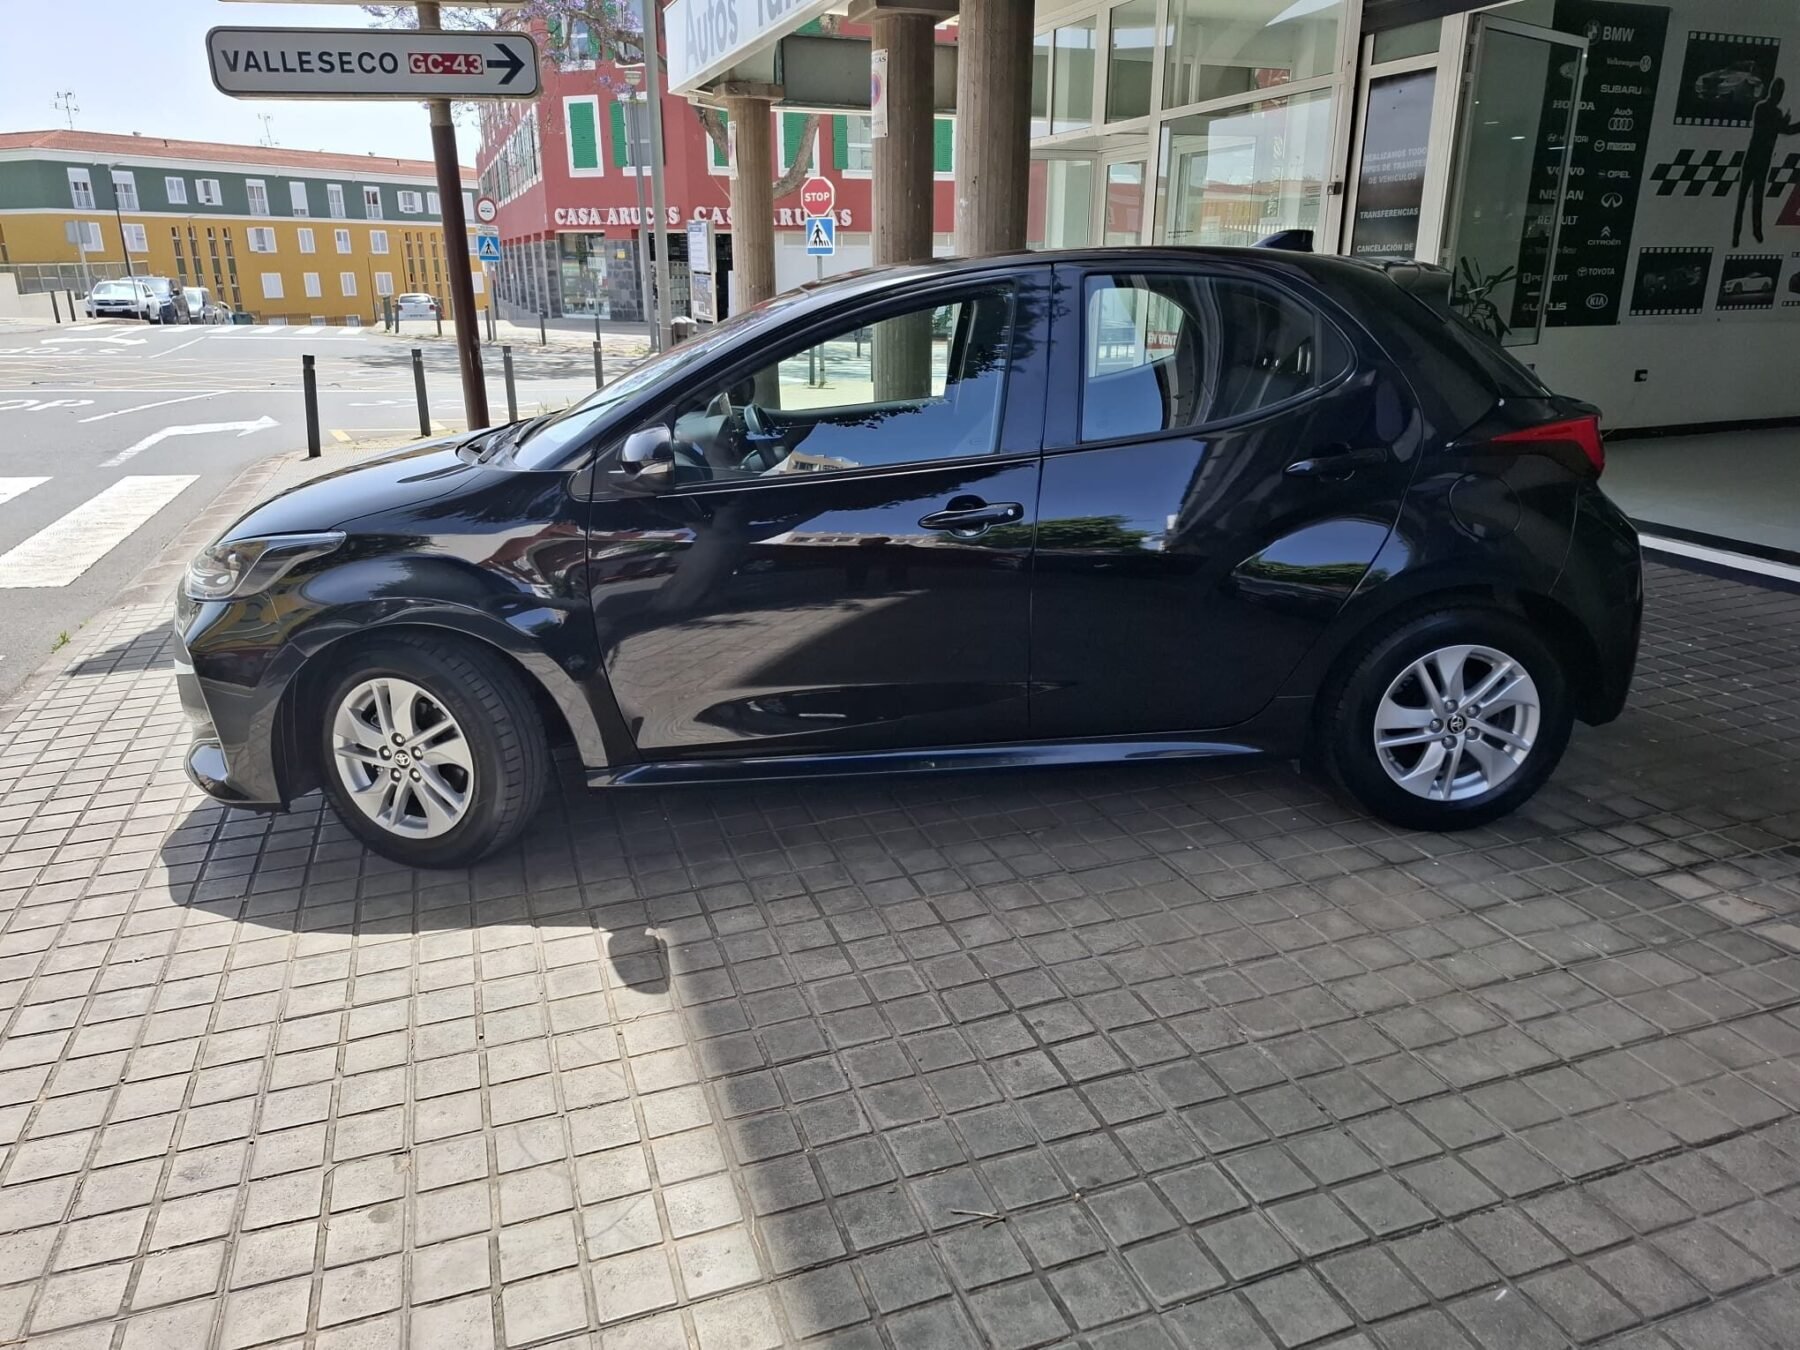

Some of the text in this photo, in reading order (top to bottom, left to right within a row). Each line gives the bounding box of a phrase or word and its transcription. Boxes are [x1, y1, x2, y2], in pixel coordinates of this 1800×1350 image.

[1602, 26, 1635, 42] BMW
[221, 50, 483, 75] VALLESECO GC-43
[1600, 84, 1642, 95] SUBARU
[1552, 99, 1595, 111] HODA
[1546, 166, 1585, 176] VOVO
[1607, 170, 1632, 179] OPEL
[804, 192, 830, 202] STOP
[1539, 189, 1584, 201] NISAN
[554, 207, 602, 225] CASA
[1360, 207, 1419, 219] TRANSFERENCIAS
[1404, 243, 1414, 251] DE
[1588, 267, 1615, 277] TOYOTA
